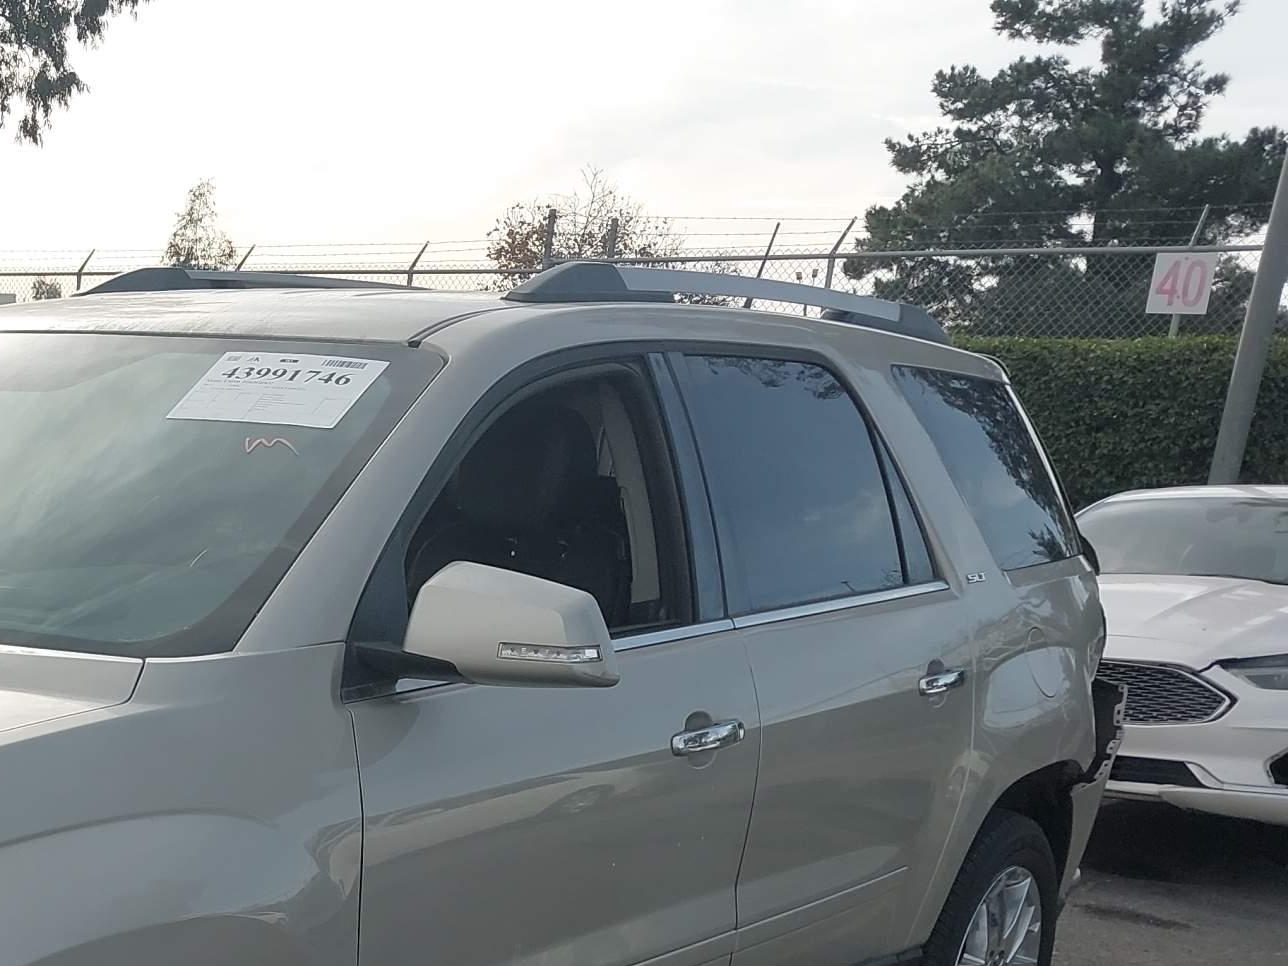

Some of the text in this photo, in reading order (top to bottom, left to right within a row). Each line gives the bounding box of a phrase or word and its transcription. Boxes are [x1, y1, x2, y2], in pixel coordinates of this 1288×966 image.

[1155, 259, 1208, 307] 40
[221, 366, 355, 386] 43991746
[966, 572, 986, 584] SLT
